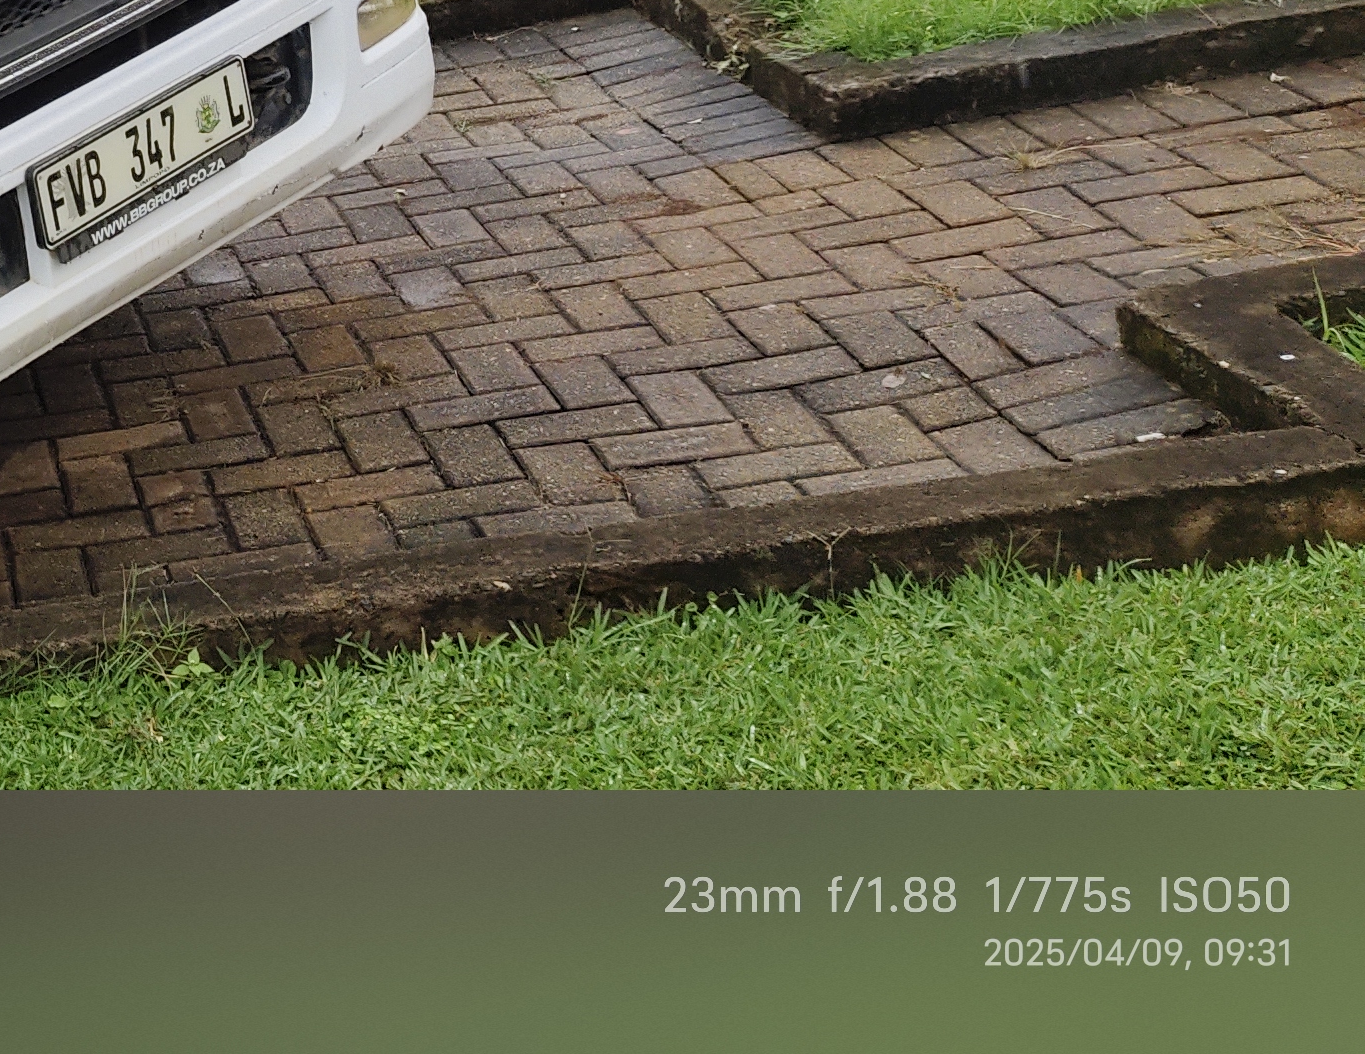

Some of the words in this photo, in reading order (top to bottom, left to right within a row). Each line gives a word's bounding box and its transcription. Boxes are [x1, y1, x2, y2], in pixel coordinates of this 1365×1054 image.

[46, 149, 107, 232] FVB
[124, 104, 176, 183] 347
[222, 74, 246, 128] L
[135, 165, 171, 190] LIMPOPO
[90, 157, 226, 246] WWW.BBGROUP.CO.ZA
